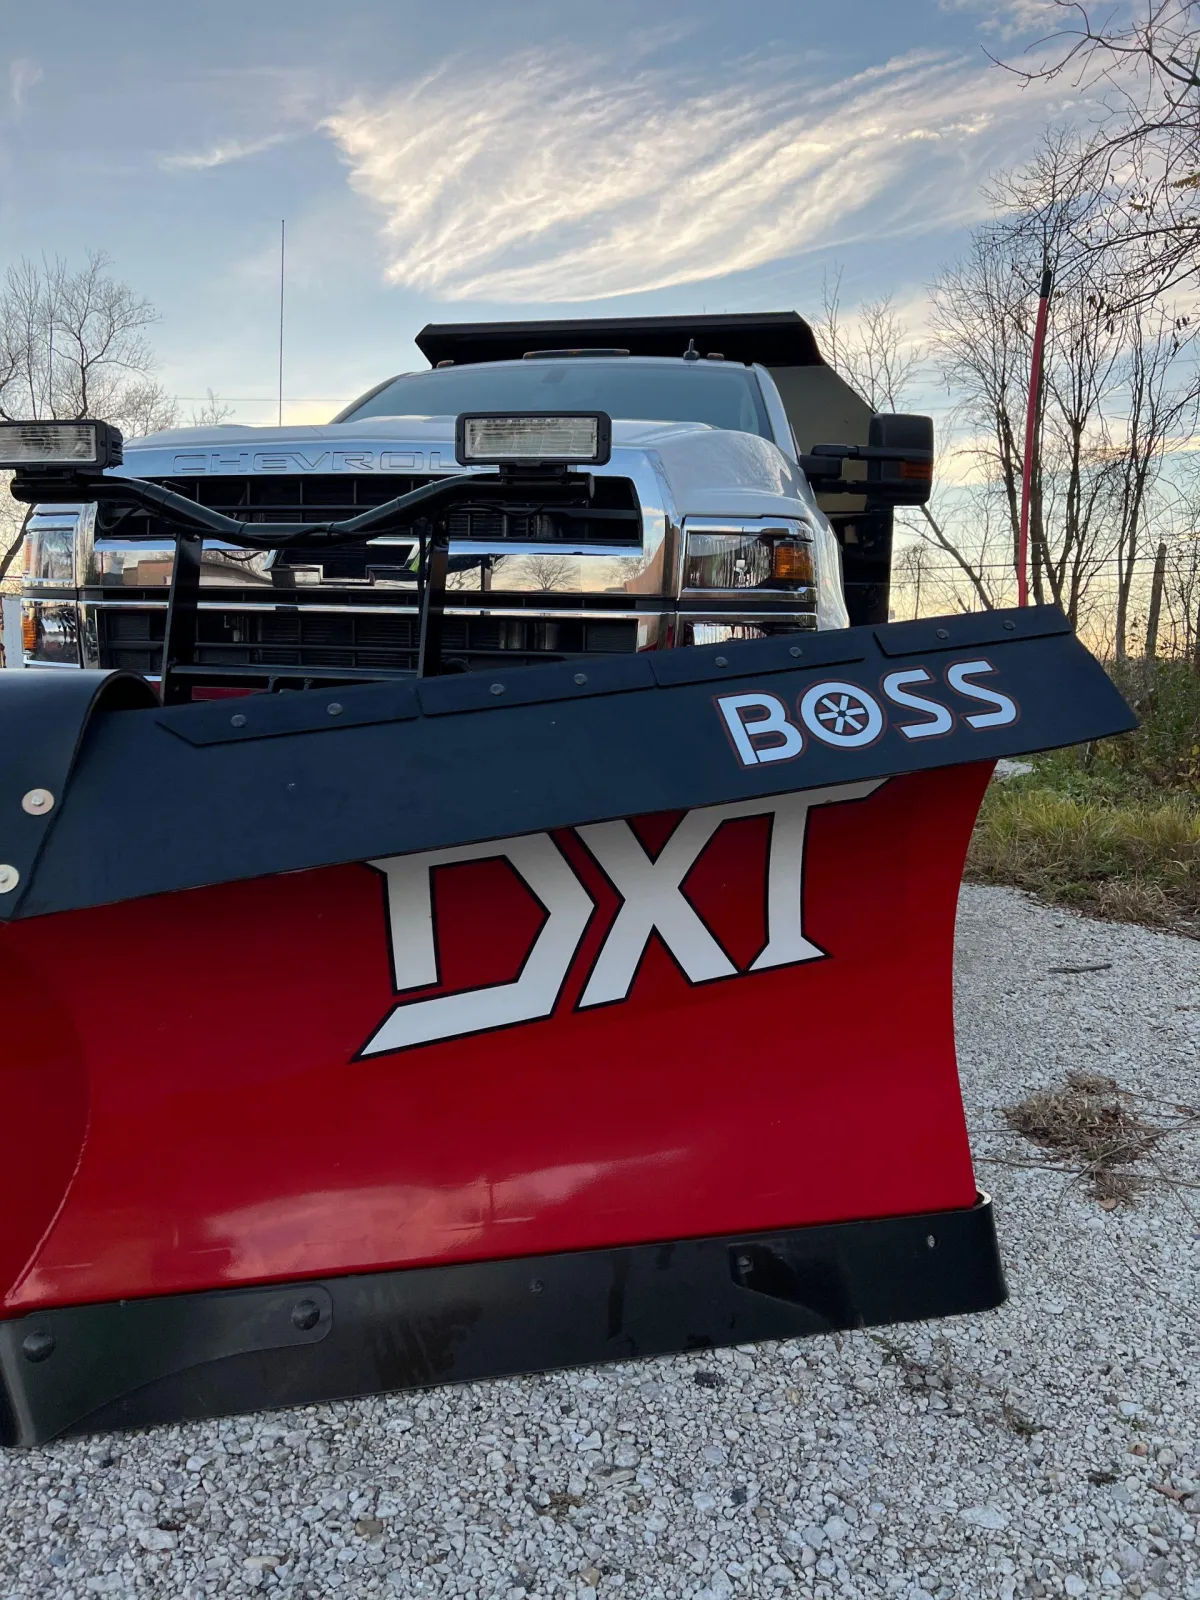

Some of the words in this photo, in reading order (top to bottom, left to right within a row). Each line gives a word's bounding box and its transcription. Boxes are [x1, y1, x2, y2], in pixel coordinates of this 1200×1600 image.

[172, 451, 499, 473] CHEVROL
[715, 659, 1019, 767] BOSS
[350, 777, 891, 1061] DXT
